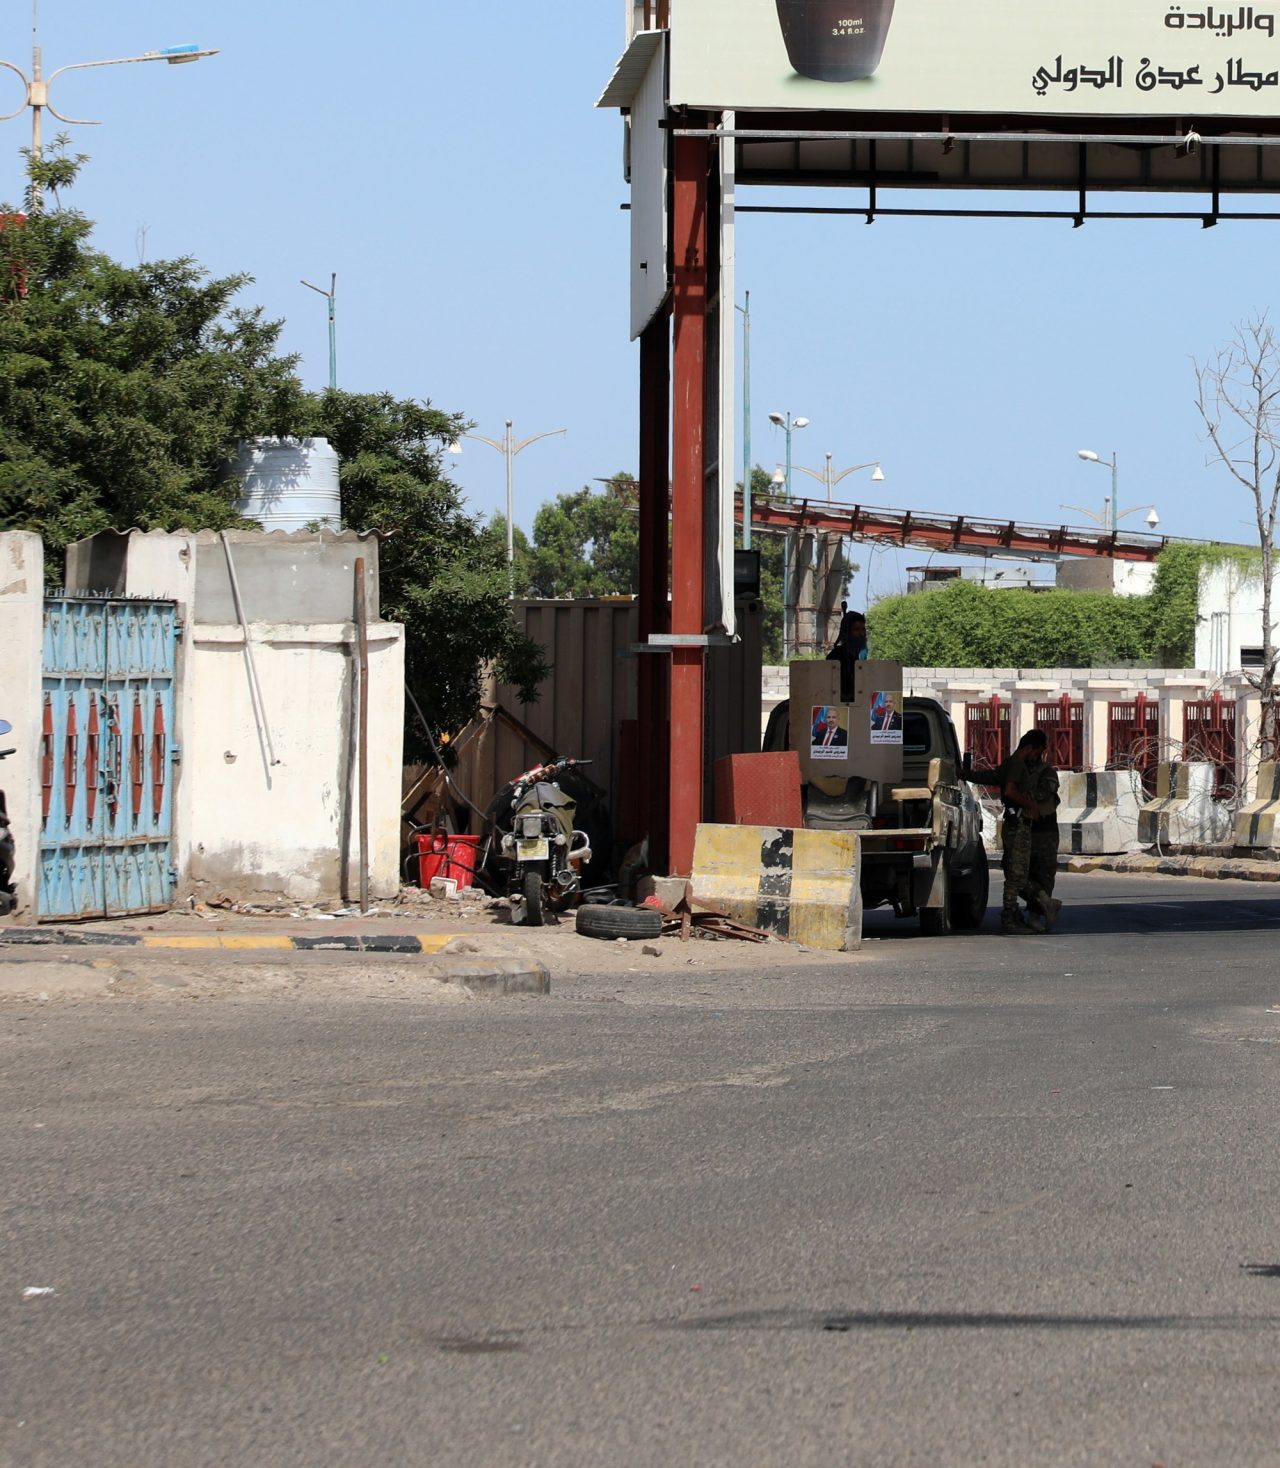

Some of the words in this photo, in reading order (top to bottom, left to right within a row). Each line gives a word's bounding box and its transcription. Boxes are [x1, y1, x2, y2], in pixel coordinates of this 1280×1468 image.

[832, 28, 845, 36] 3.4
[838, 18, 863, 28] 100ml
[1164, 6, 1275, 38] والريادة
[1032, 54, 1124, 96] الدولي
[1135, 57, 1203, 92] عدن
[1208, 57, 1279, 94] مطار
